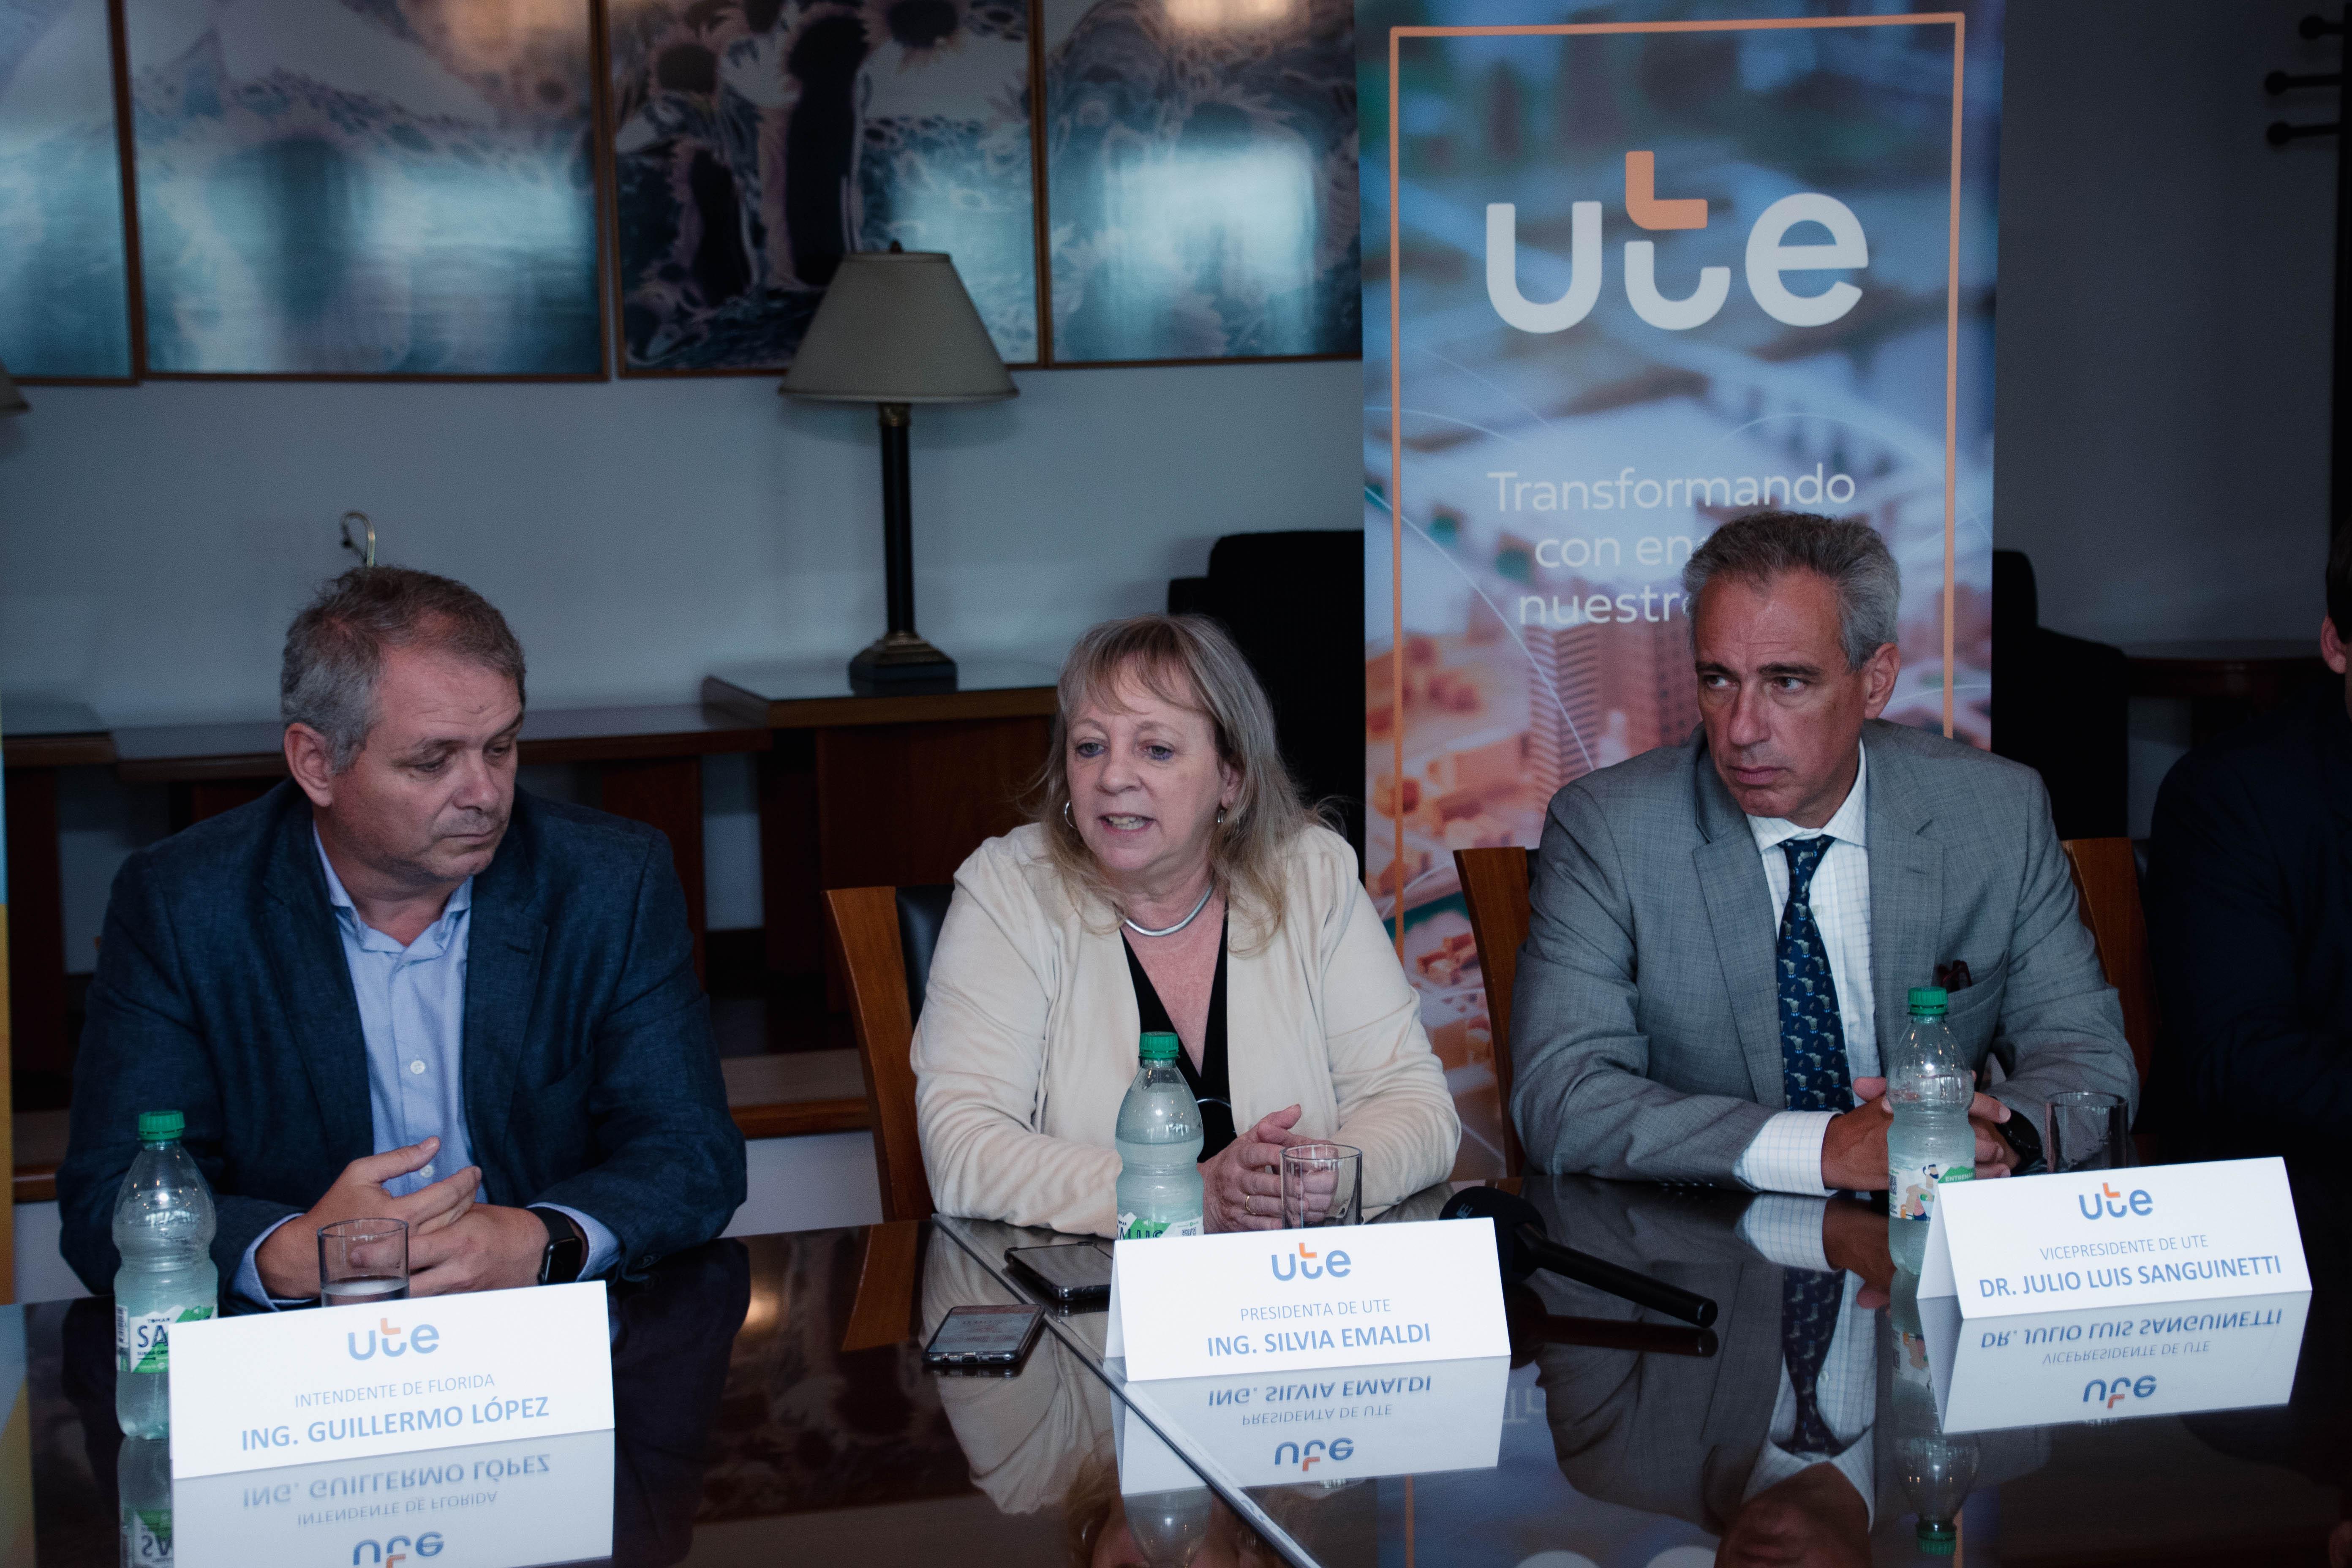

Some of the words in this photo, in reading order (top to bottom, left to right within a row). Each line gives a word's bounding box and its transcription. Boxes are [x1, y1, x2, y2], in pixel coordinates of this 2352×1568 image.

[1486, 151, 1868, 333] ute
[1487, 463, 1856, 512] Transformando
[1535, 536, 1620, 568] con
[1636, 535, 1708, 566] en
[1522, 585, 1689, 624] nuestr
[2079, 1183, 2152, 1220] ute
[1271, 1243, 1351, 1281] ute
[2040, 1239, 2155, 1260] VICEPRESIDENTE
[2159, 1237, 2177, 1250] DE
[2181, 1235, 2208, 1249] UTE
[1980, 1278, 2016, 1297] DR.
[2024, 1272, 2081, 1294] JULIO
[2087, 1267, 2132, 1288] LUIS
[2137, 1255, 2281, 1284] SANGUINETTI
[1241, 1303, 1333, 1321] PRESIDENTA
[1338, 1301, 1356, 1315] DE
[1362, 1299, 1390, 1313] UTE
[348, 1318, 439, 1361] ute
[1208, 1336, 1257, 1356] ING.
[1265, 1330, 1334, 1353] SILVIA
[1342, 1323, 1430, 1347] EMALDI
[295, 1384, 396, 1407] INTENDENTE
[403, 1381, 422, 1396] DE
[429, 1374, 495, 1393] FLORIDA
[242, 1426, 298, 1451] ING.
[308, 1406, 463, 1442] GUILLERMO
[472, 1396, 549, 1424] LÓPEZ
